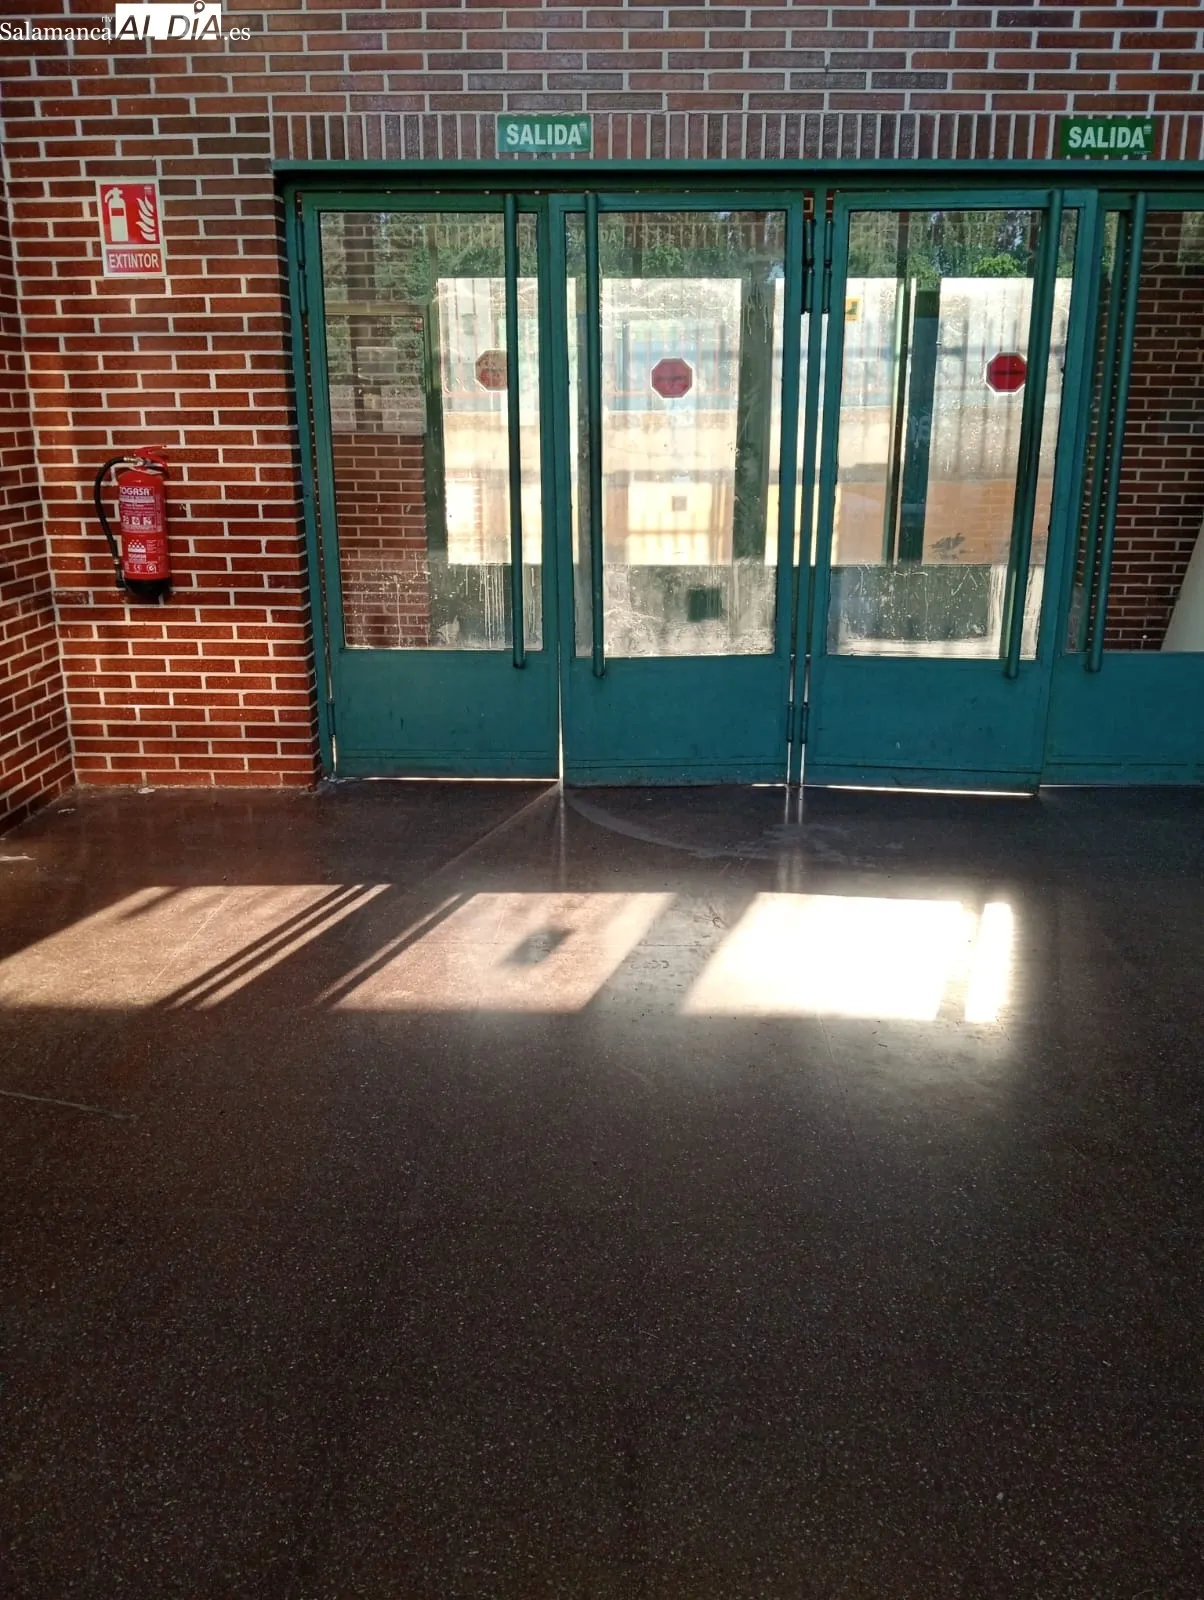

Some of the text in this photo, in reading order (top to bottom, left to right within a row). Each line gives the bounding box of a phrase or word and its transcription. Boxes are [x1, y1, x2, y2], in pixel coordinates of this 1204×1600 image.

[506, 123, 582, 145] SALIDA
[1068, 126, 1145, 148] SALIDA
[108, 253, 159, 269] EXTINTOR
